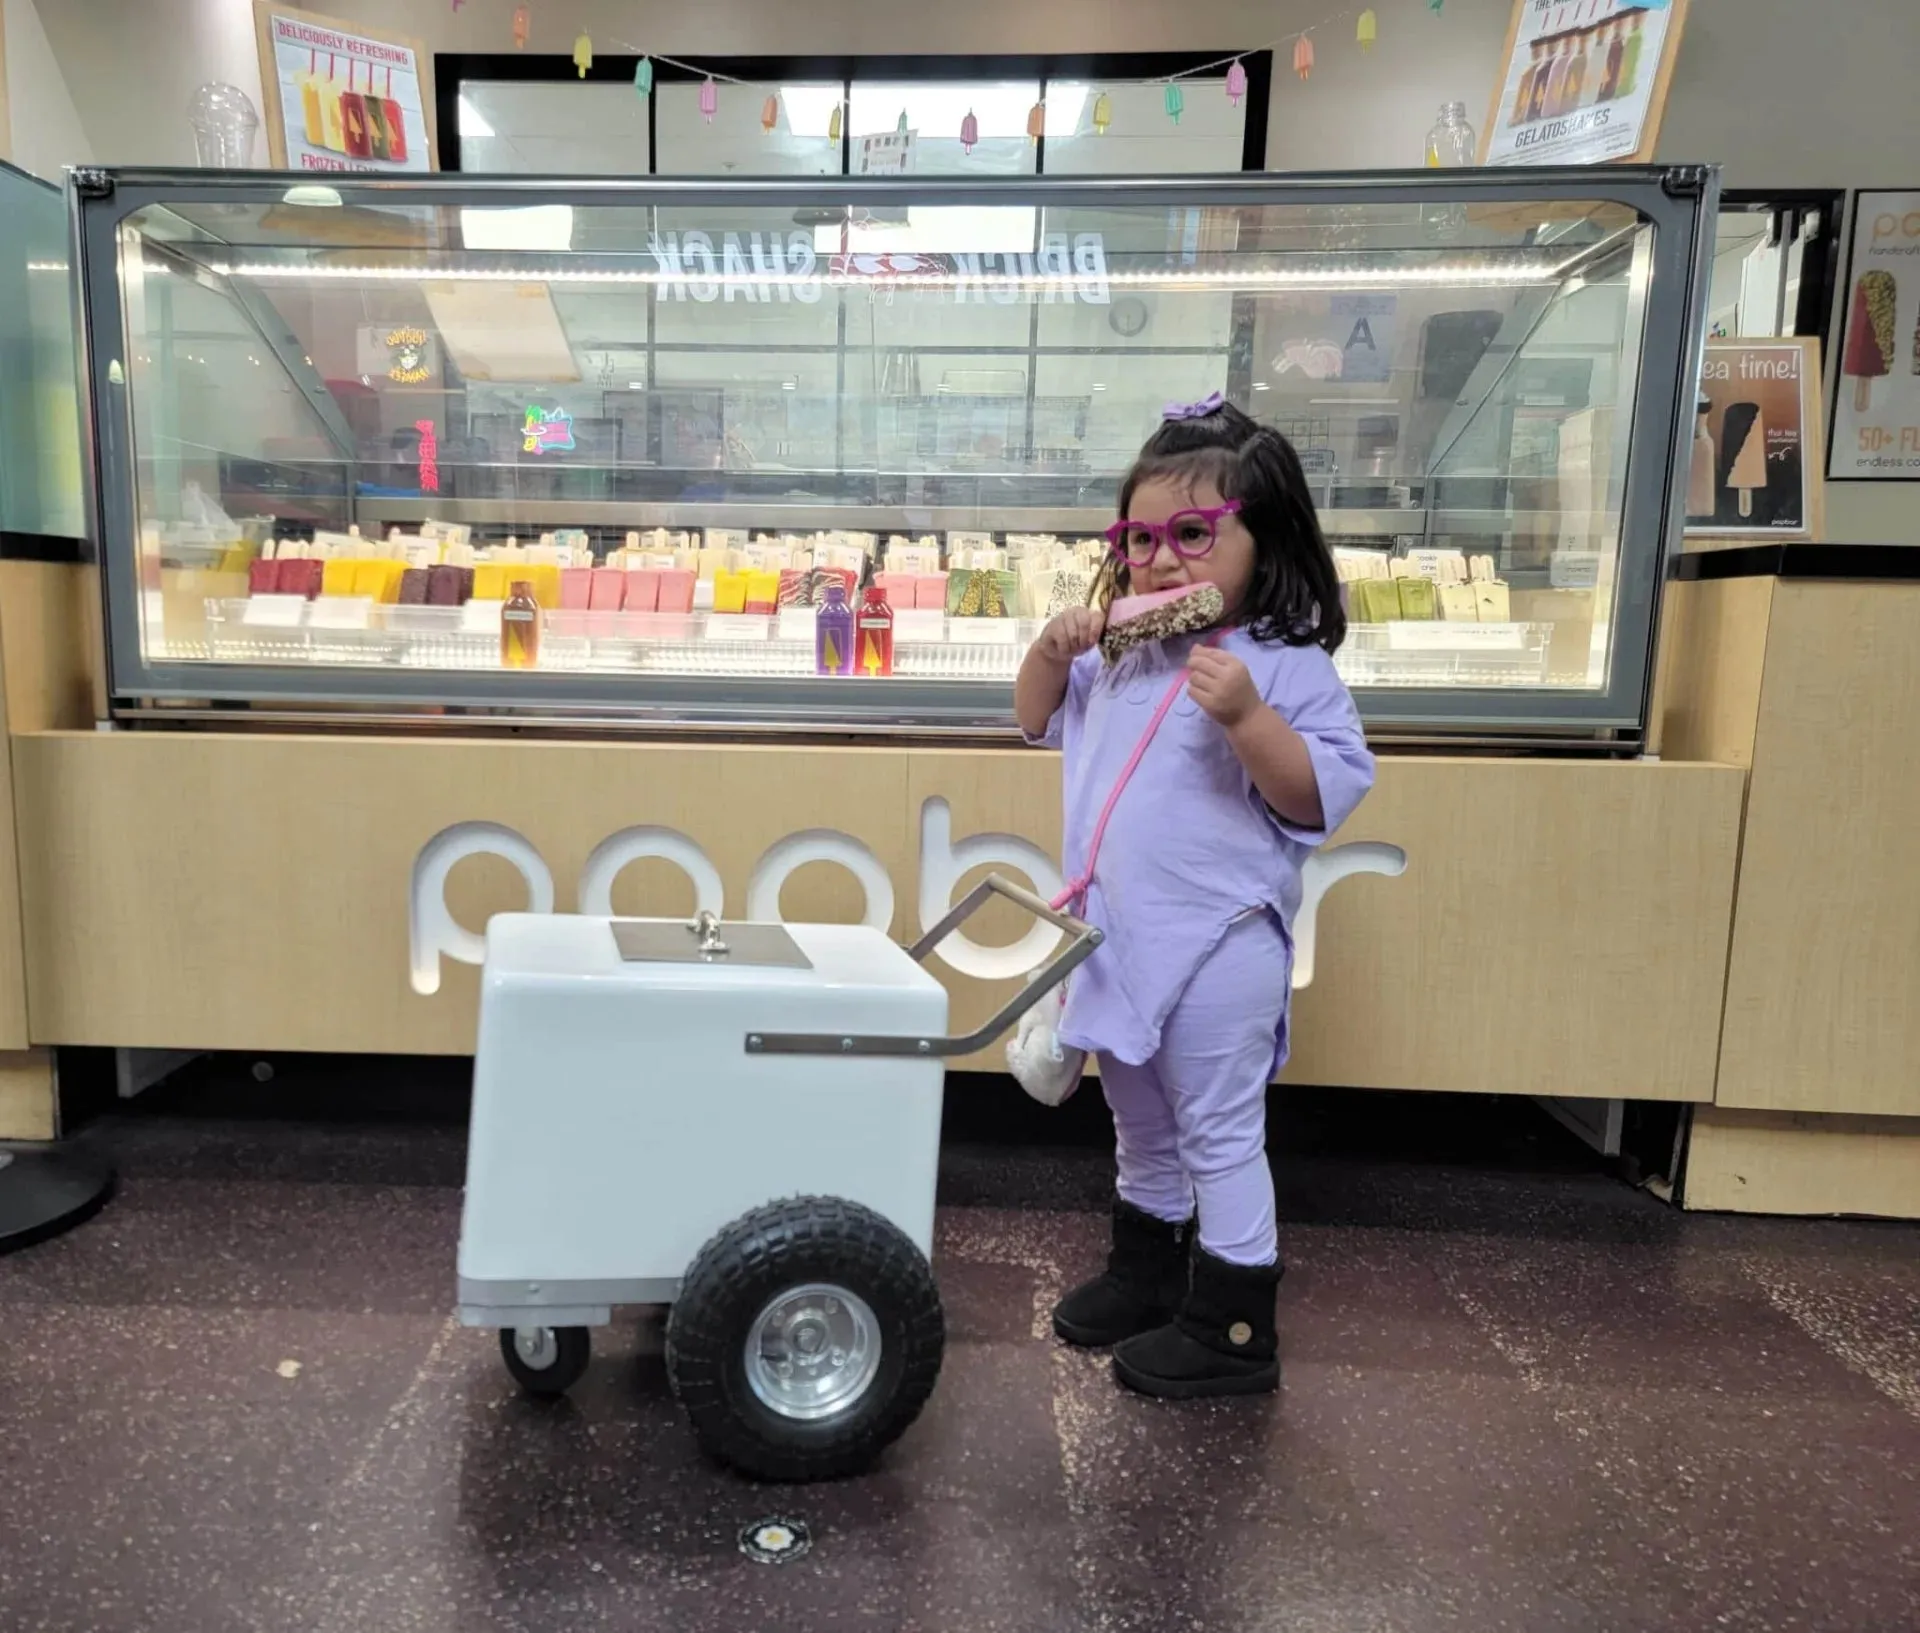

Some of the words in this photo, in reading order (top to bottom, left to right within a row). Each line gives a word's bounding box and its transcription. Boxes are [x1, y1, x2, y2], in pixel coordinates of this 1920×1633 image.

[278, 22, 344, 50] DELICIOUSLY
[346, 39, 408, 65] REFRESHING
[1739, 351, 1799, 380] time!
[1858, 426, 1895, 451] 50+
[1856, 456, 1904, 467] endless
[410, 795, 1407, 994] popbr
